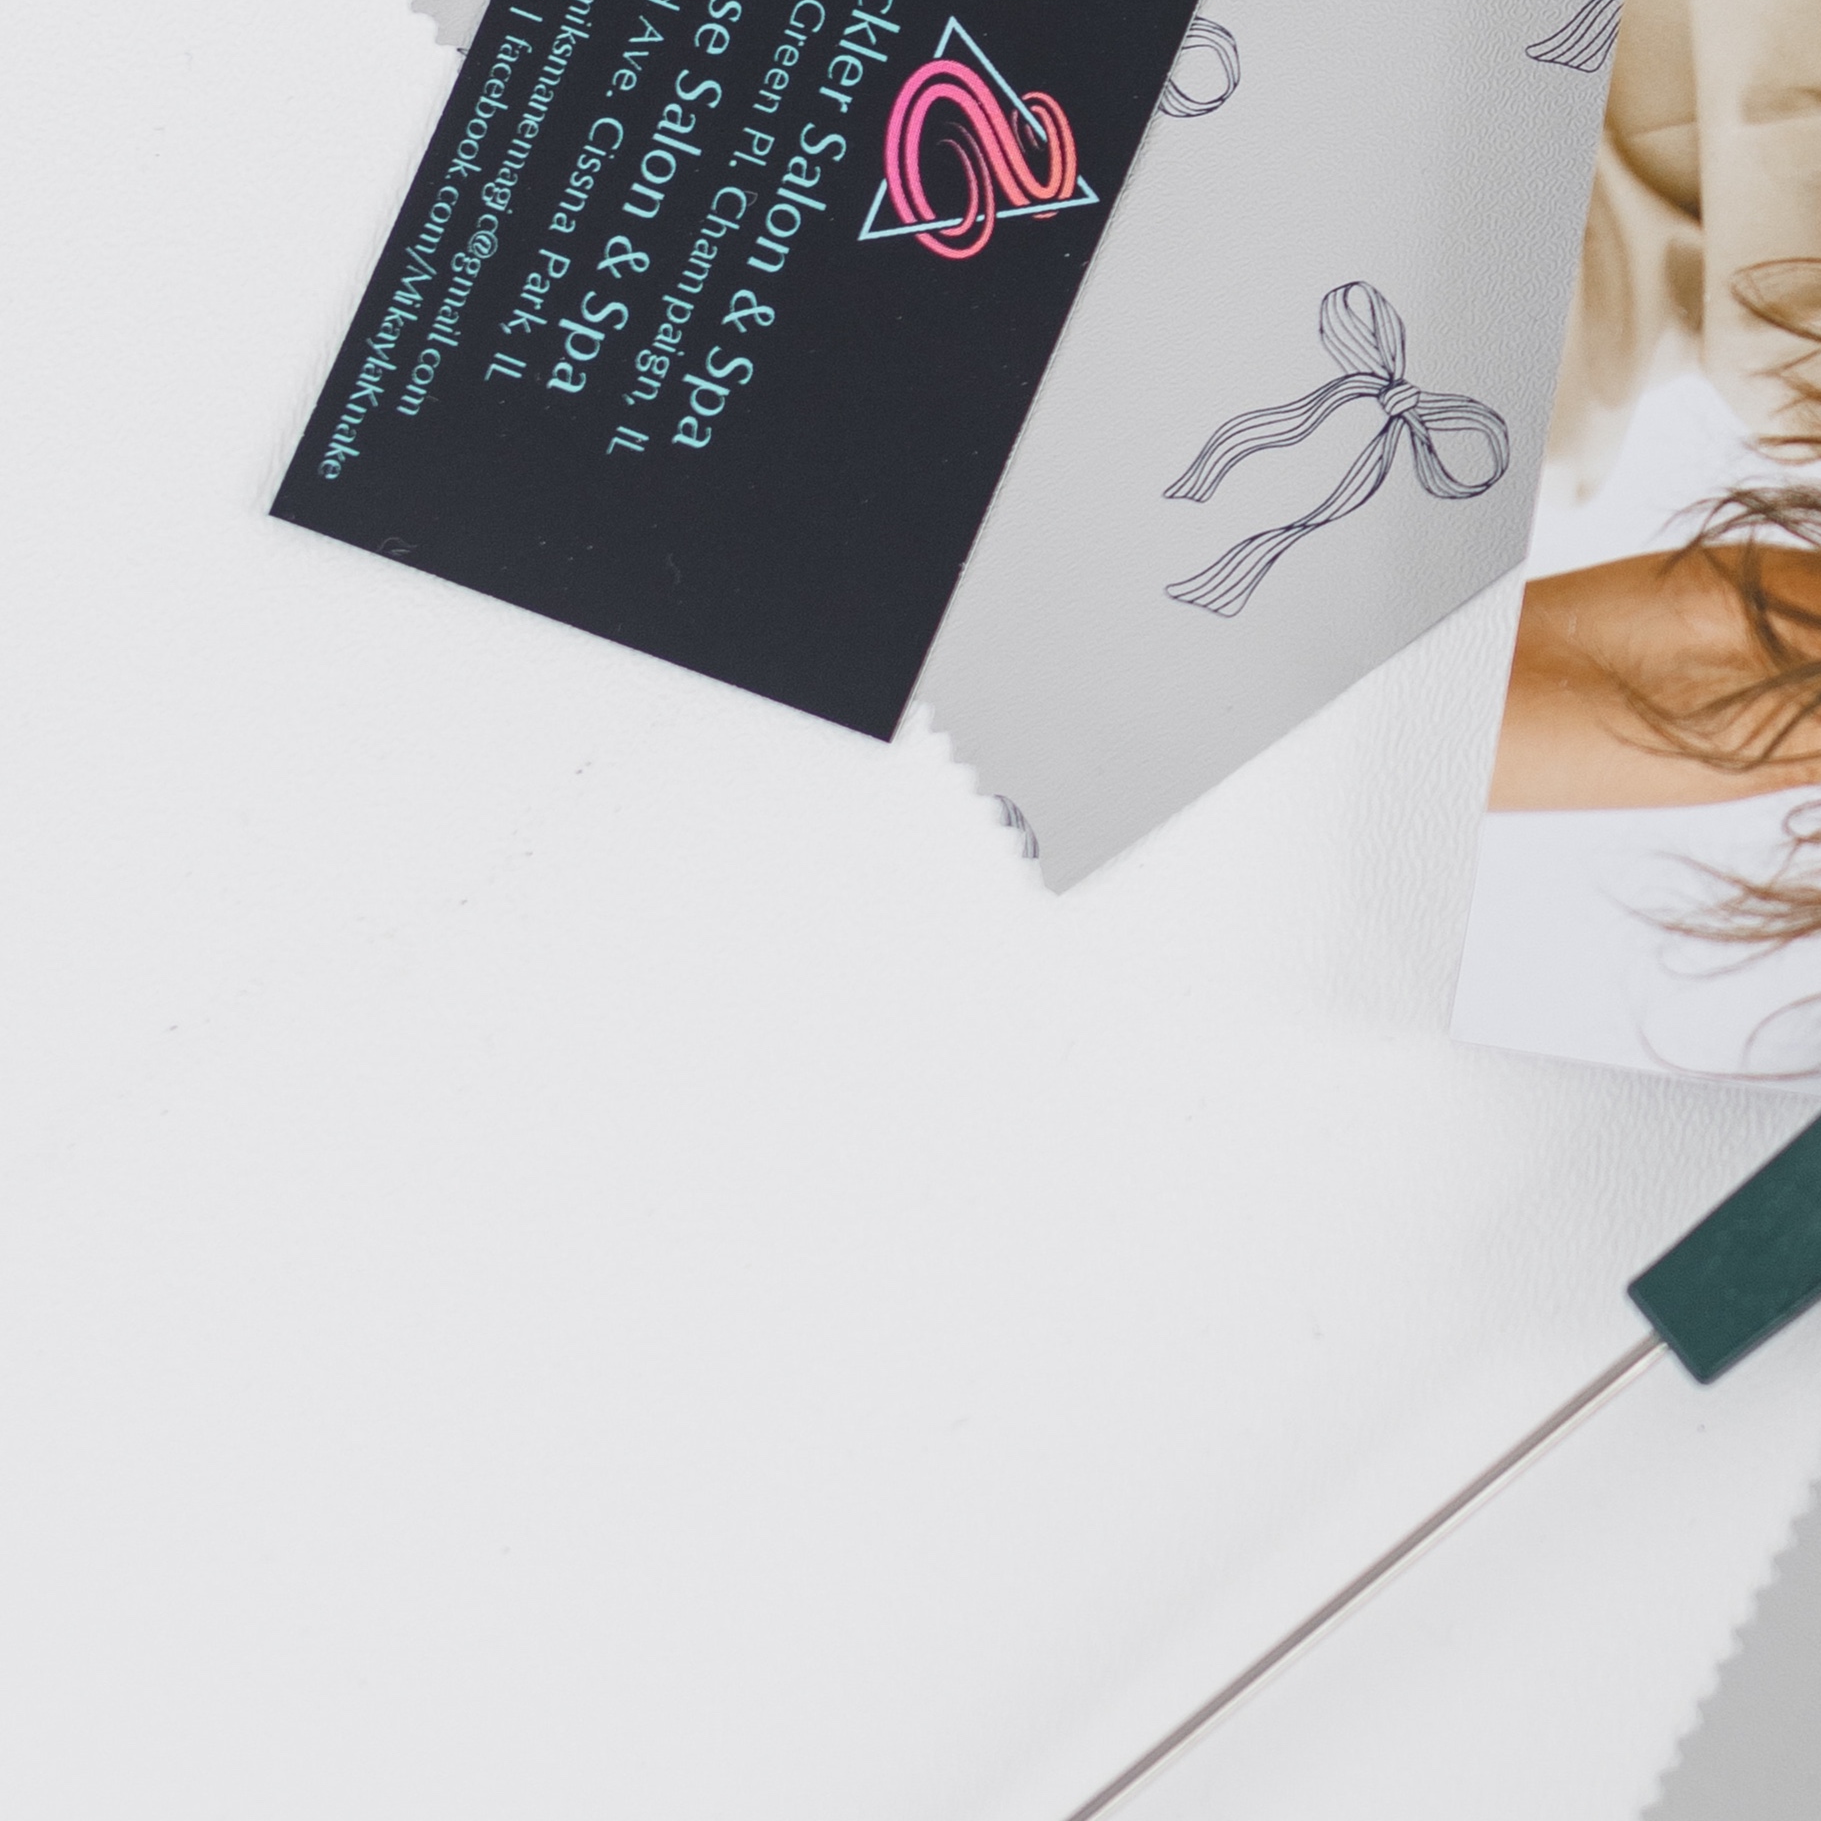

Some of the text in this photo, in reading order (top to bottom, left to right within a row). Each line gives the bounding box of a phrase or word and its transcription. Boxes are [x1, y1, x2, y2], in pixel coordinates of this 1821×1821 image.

[606, 15, 665, 97] Ave.
[549, 117, 624, 233] Cissna
[622, 69, 723, 219] Salon
[729, 127, 775, 167] Pl.
[747, 122, 847, 273] Salon
[502, 248, 571, 334] Park,
[597, 235, 650, 279] &
[626, 186, 747, 405] Champaign,
[547, 290, 629, 393] Spa
[722, 289, 775, 333] &
[485, 352, 527, 380] IL
[672, 345, 754, 449] Spa
[608, 426, 650, 454] IL
